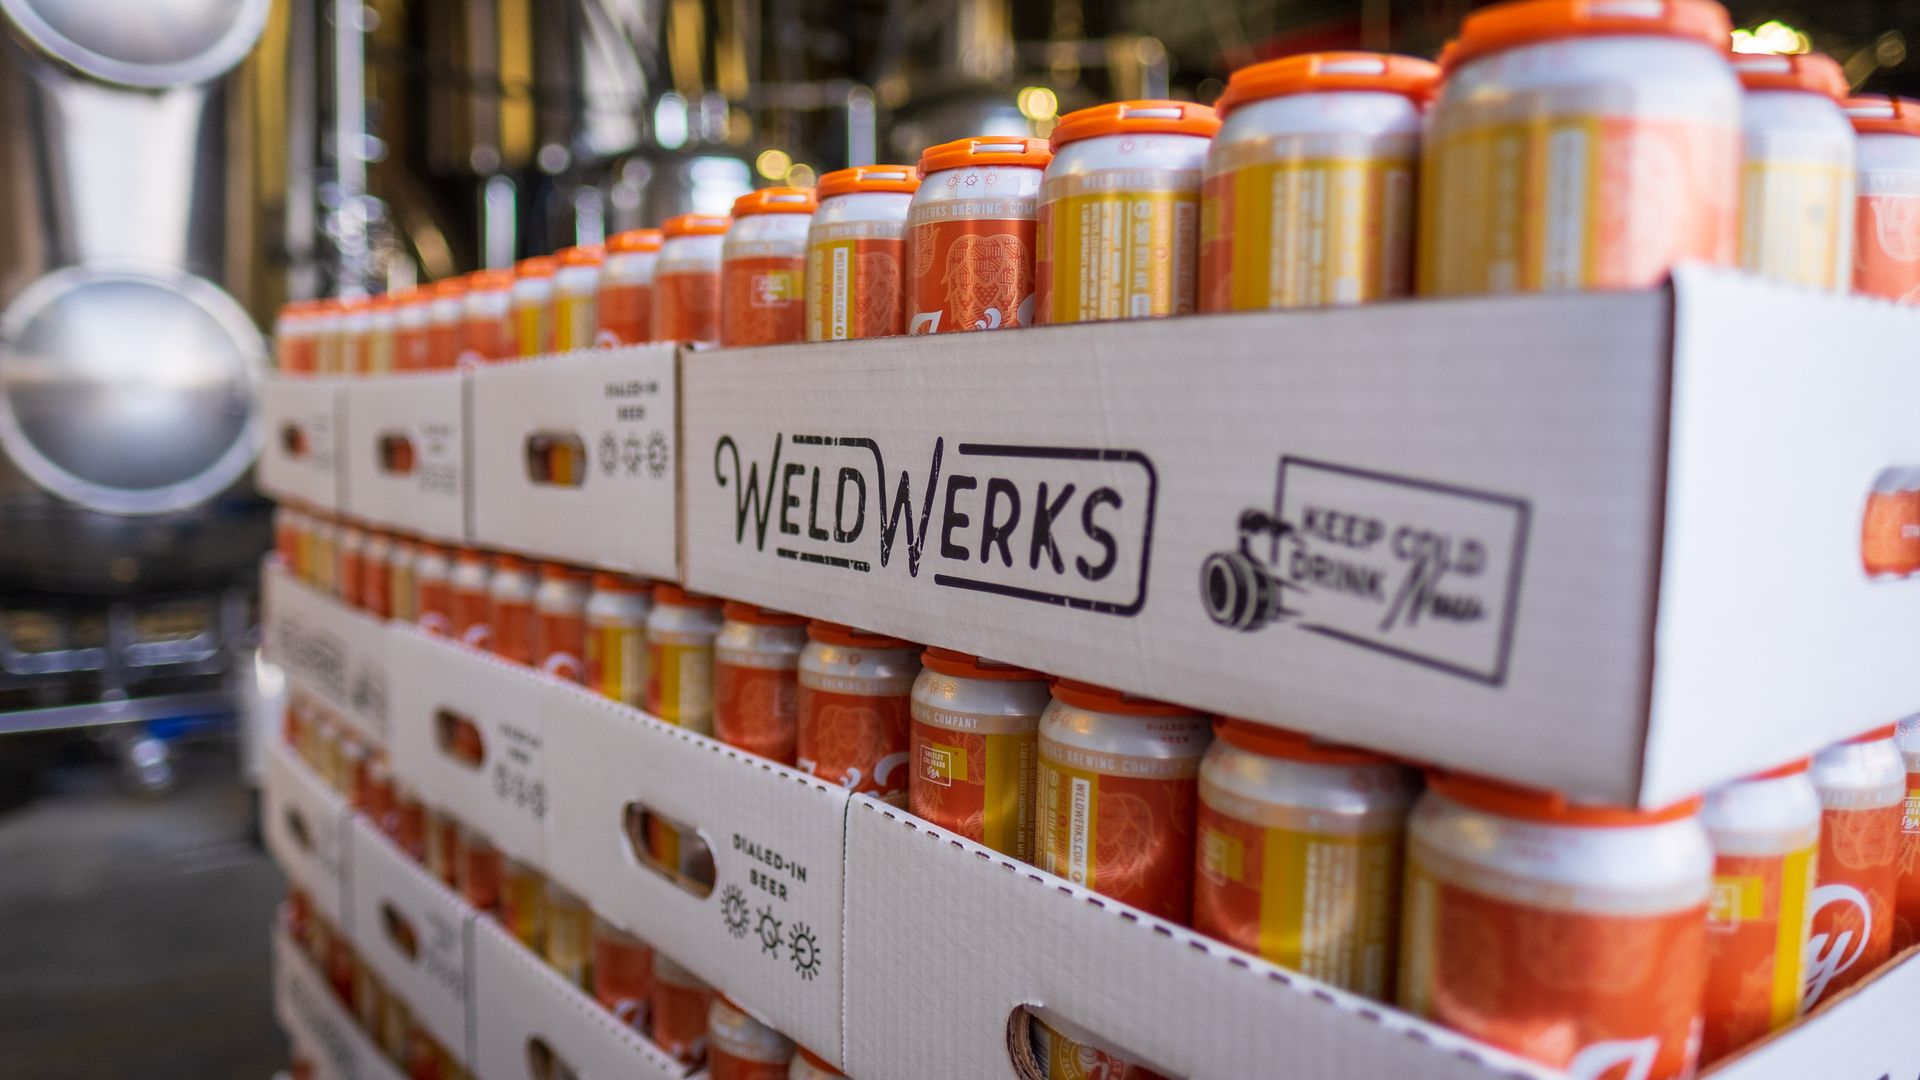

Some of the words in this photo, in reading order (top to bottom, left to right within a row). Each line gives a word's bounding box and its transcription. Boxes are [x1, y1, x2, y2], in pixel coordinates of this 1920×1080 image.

[952, 202, 1002, 216] BREWING
[714, 432, 1122, 582] WELDWERKS
[1302, 505, 1385, 551] KEEP
[1392, 525, 1487, 577] COLD
[1290, 549, 1386, 603] DRINK
[934, 712, 978, 729] COMPANY
[1066, 752, 1115, 770] BREWING
[1073, 783, 1086, 867] WELDWERKS.COM
[732, 833, 807, 883] DIALED-IN
[749, 868, 788, 902] BEER
